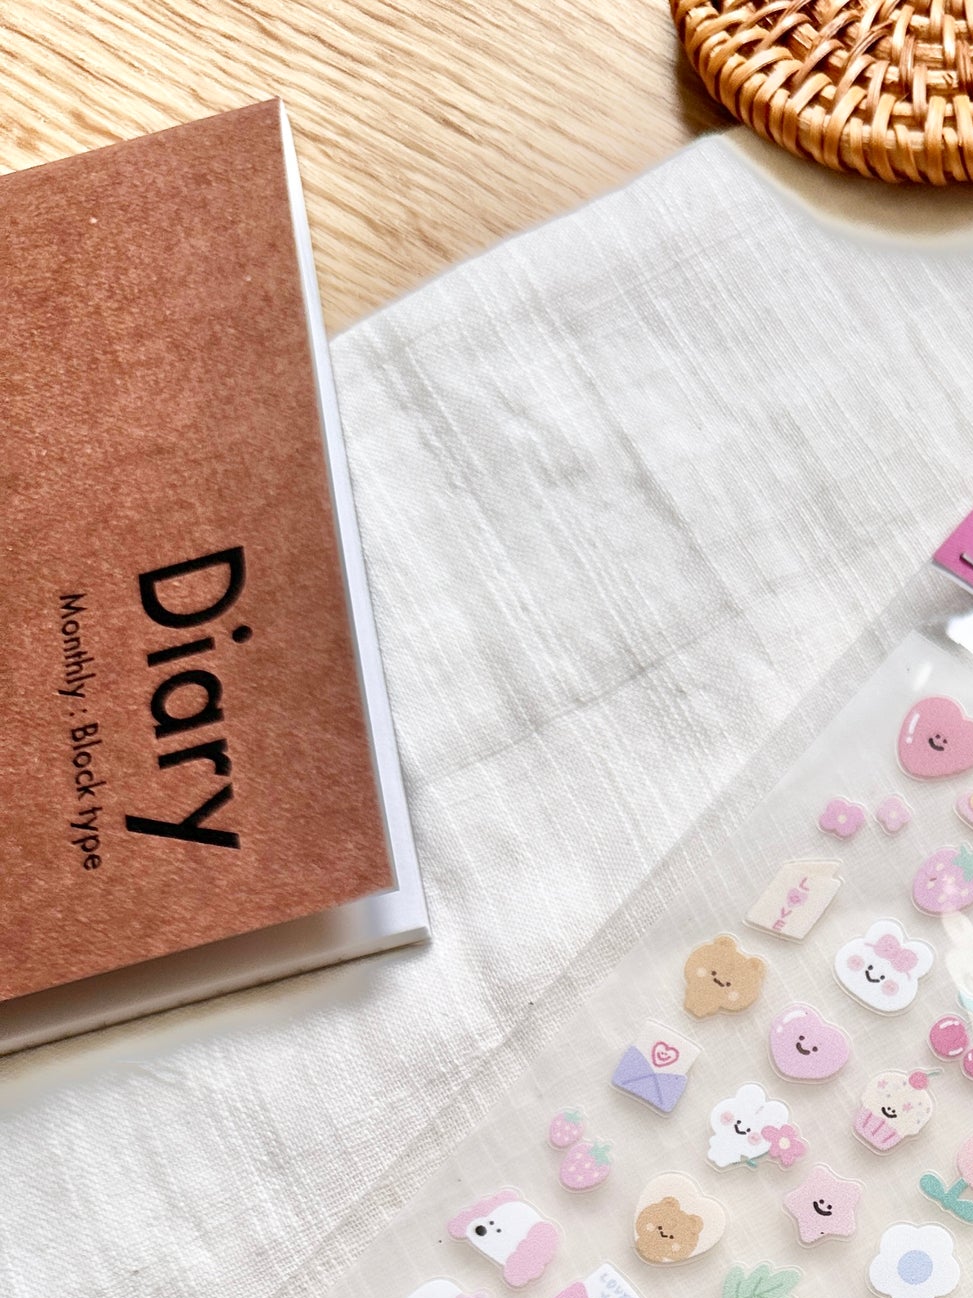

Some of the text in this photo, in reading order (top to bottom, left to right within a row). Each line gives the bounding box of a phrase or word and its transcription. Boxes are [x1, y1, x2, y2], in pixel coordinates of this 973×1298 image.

[58, 593, 97, 699] Monthly
[125, 546, 253, 850] Diary
[70, 722, 107, 796] Block
[70, 806, 104, 872] type
